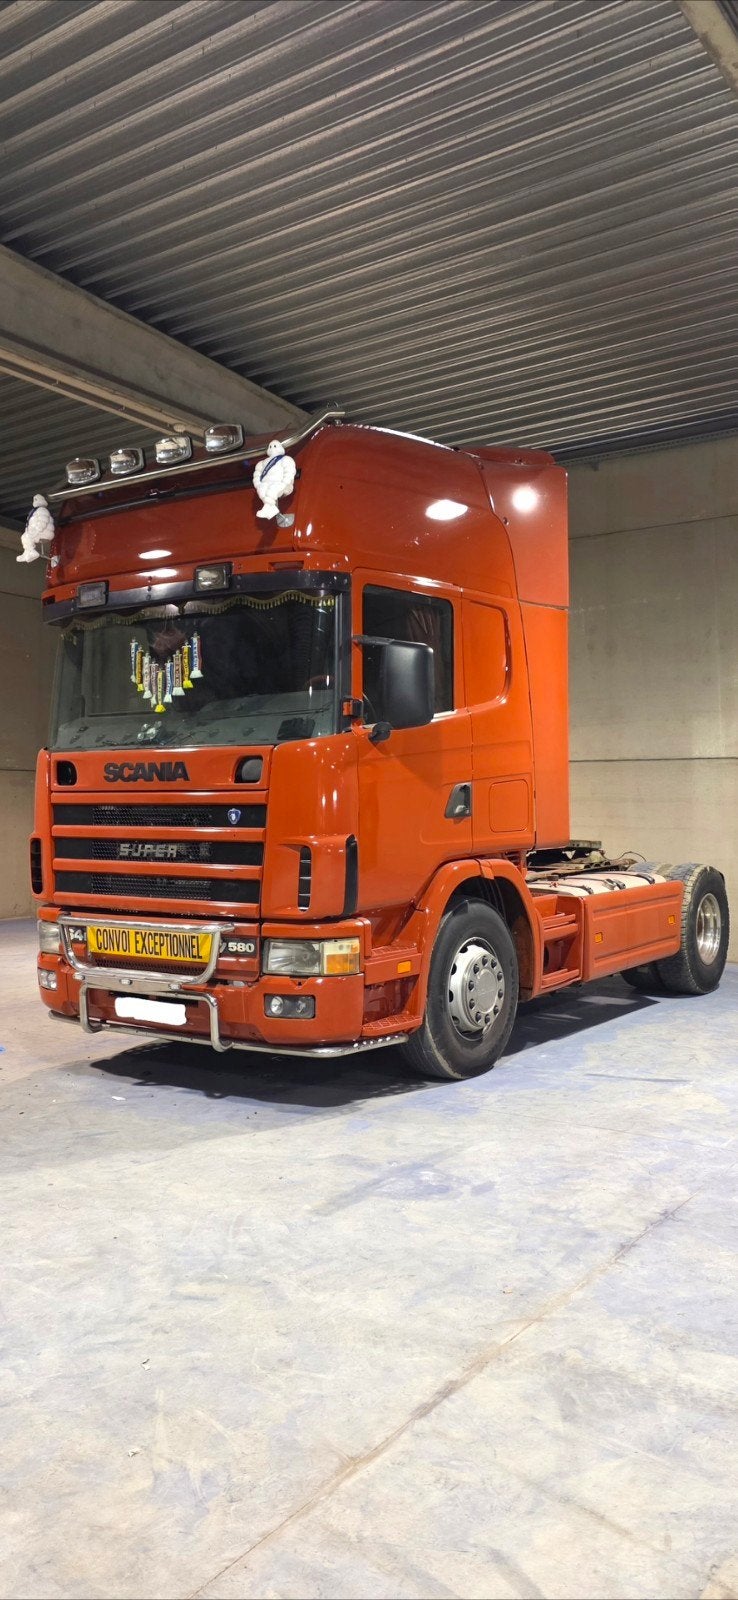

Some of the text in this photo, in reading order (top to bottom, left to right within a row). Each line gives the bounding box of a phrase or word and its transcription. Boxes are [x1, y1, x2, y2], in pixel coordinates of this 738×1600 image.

[103, 761, 190, 782] SCANIA
[119, 843, 178, 857] SUPER
[96, 929, 130, 953] CONVOI
[134, 931, 202, 959] EXCEPTIONNEL
[227, 941, 255, 953] 580
